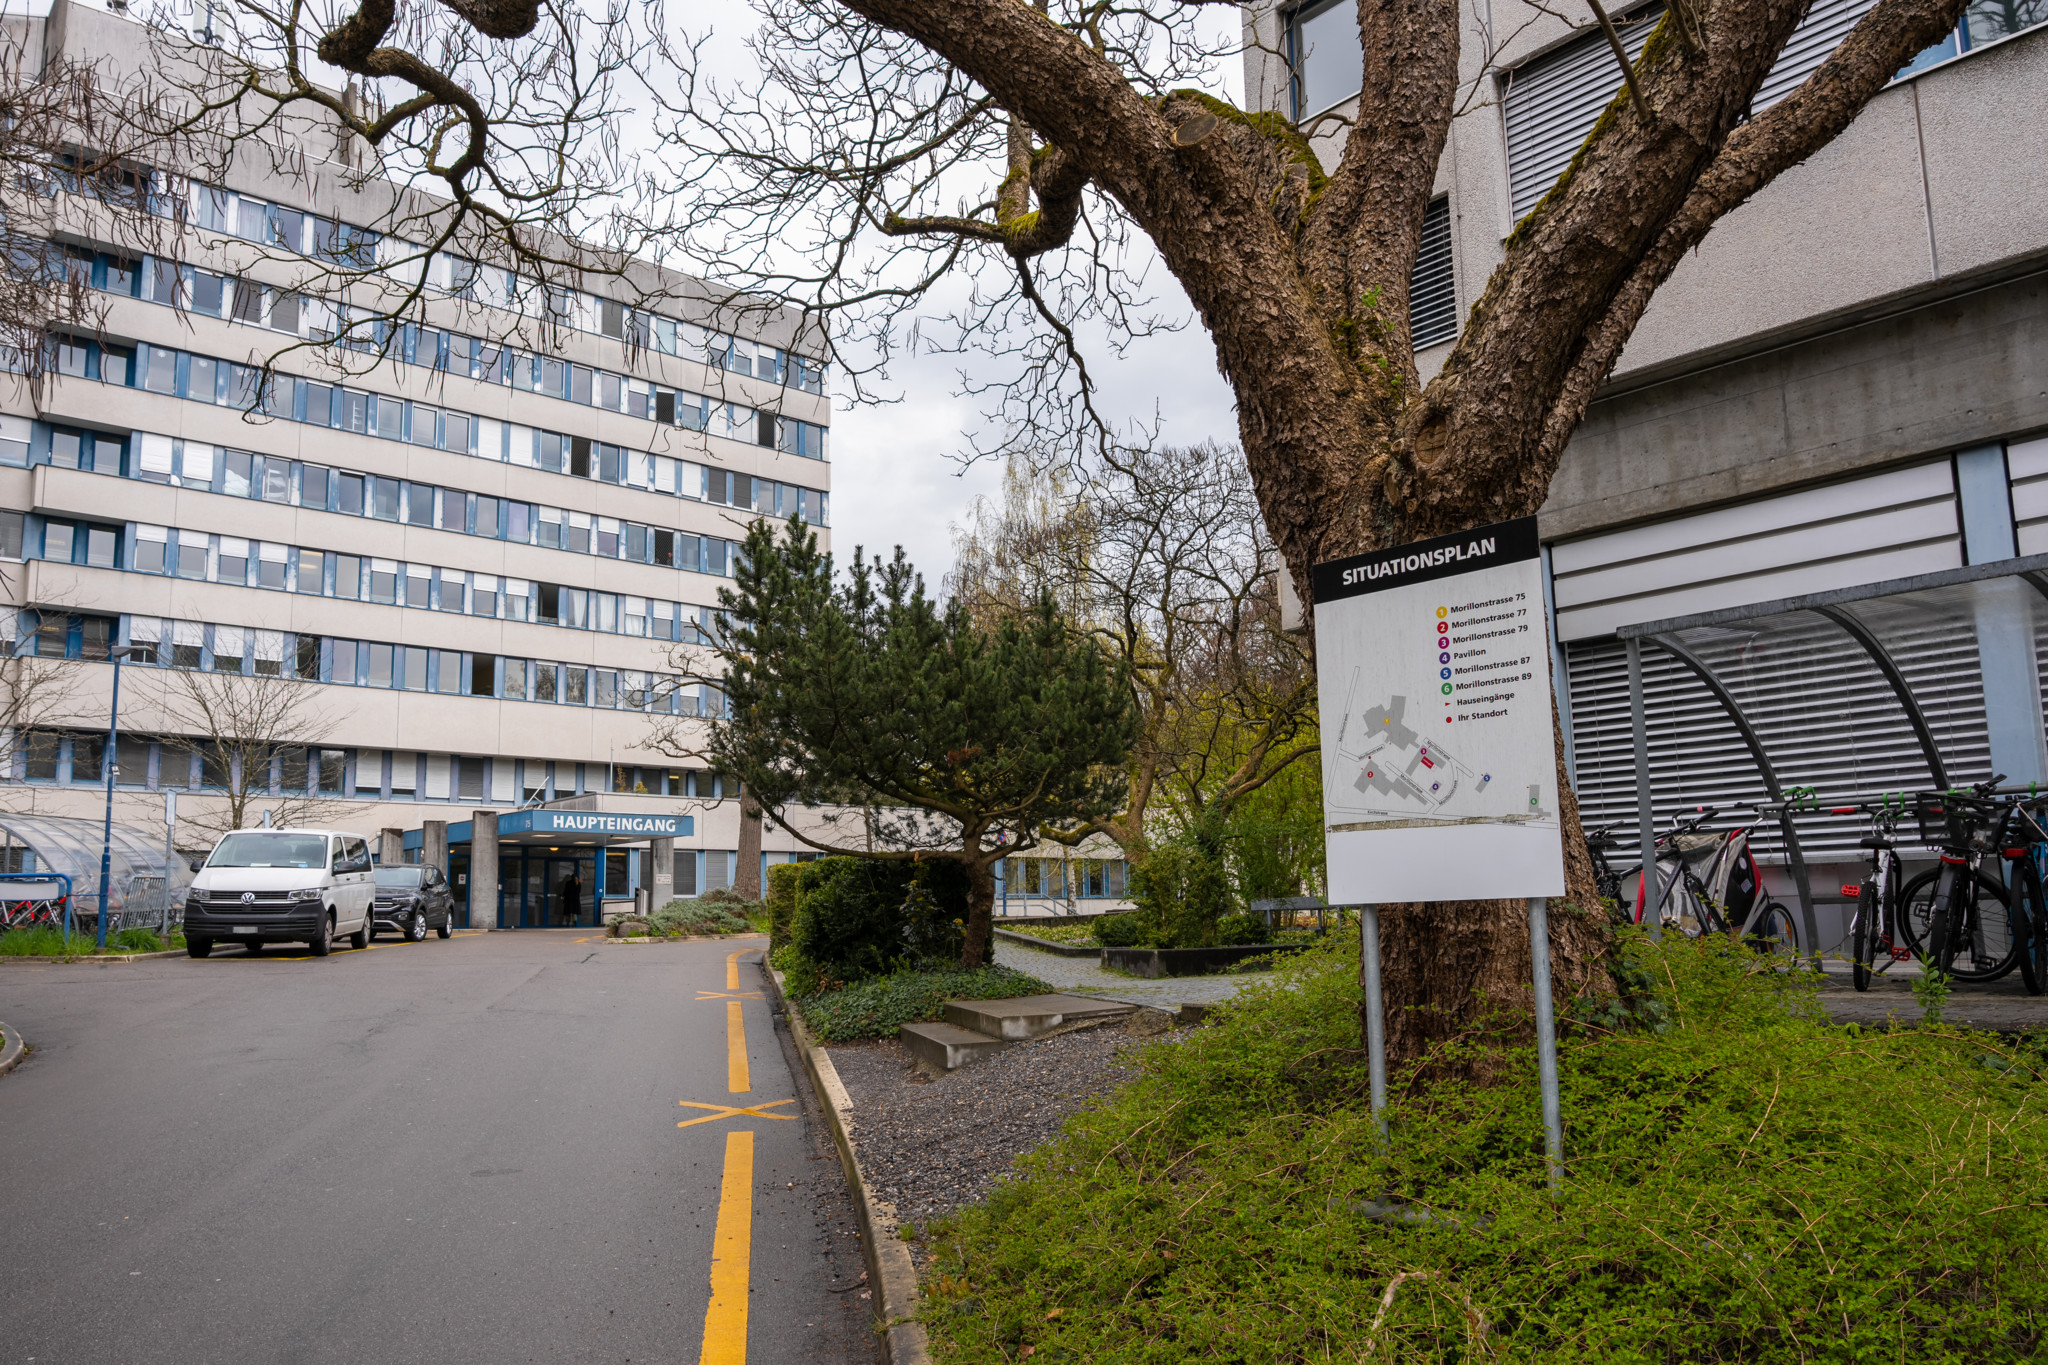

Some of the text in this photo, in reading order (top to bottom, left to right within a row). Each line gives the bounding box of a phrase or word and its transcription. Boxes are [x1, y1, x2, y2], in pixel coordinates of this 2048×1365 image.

[1342, 537, 1496, 586] SITUATIONSPLAN
[1450, 596, 1514, 613] Morillonstrasse
[1515, 592, 1526, 601] 75
[1451, 612, 1515, 629] Morillonstrasse
[1516, 608, 1527, 617] 77
[1452, 628, 1516, 644] Morillonstrasse
[1517, 624, 1529, 633] 79
[1453, 649, 1487, 660] Pavillon
[1454, 660, 1519, 675] Morillonstrasse
[1520, 656, 1531, 665] 87
[1455, 675, 1520, 691] Morillonstrasse
[1521, 672, 1532, 681] 89
[1456, 692, 1515, 706] Hauseingänge
[1457, 708, 1508, 722] Ihr Standort
[553, 815, 676, 833] HAUPTEINGANG
